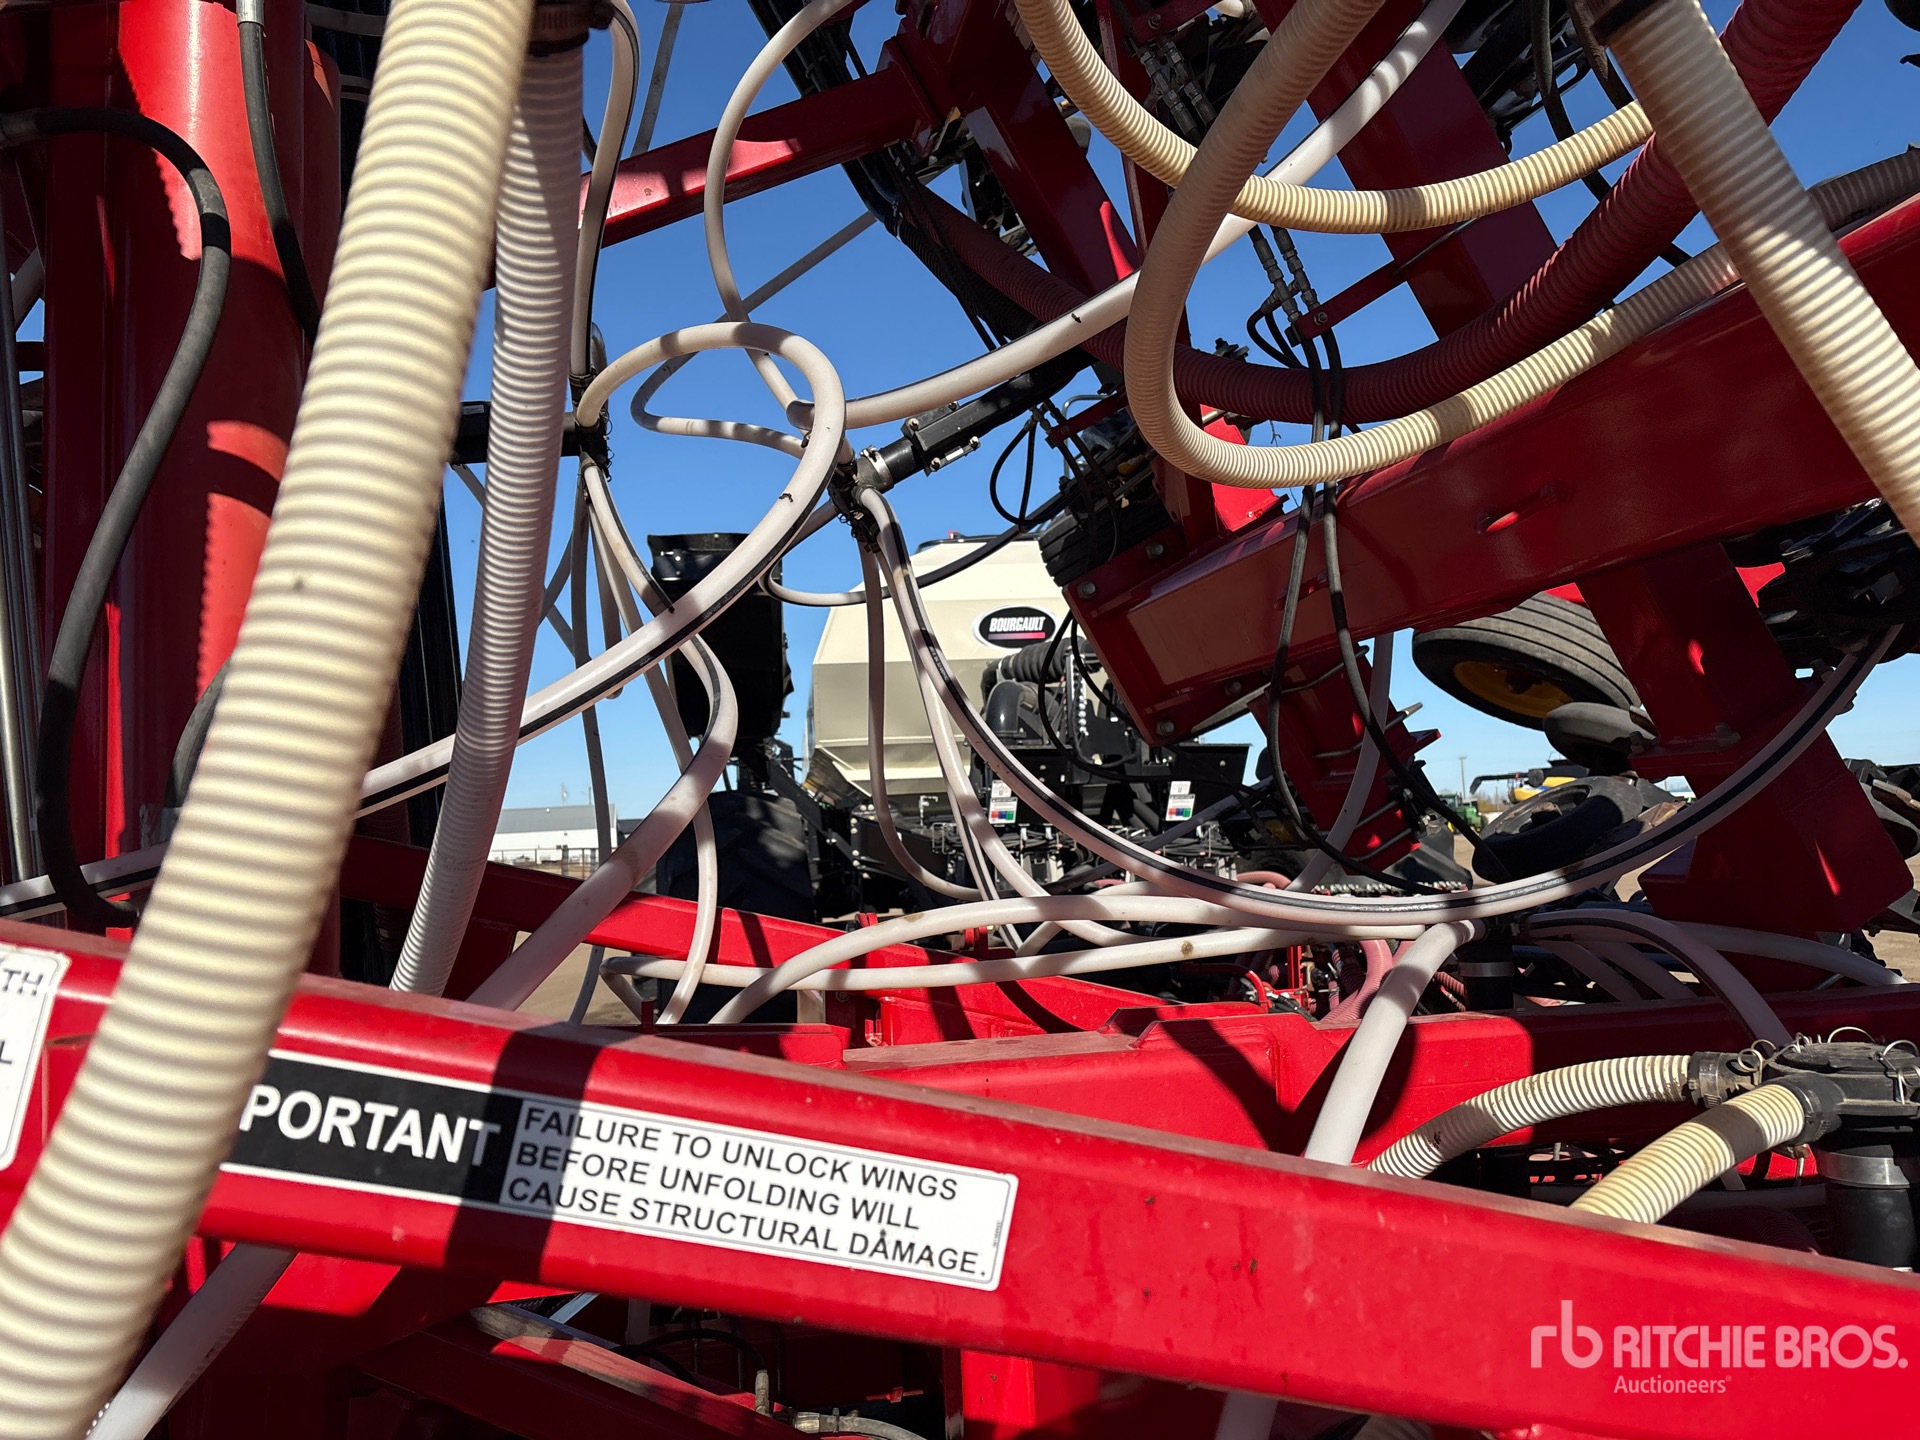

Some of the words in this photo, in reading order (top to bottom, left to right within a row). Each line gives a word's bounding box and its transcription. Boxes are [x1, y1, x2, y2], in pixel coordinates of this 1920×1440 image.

[989, 616, 1046, 632] BOURGAULT
[239, 1084, 501, 1166] PORTANT
[524, 1107, 661, 1151] FAILURE
[672, 1131, 712, 1158] TO
[722, 1141, 852, 1183] UNLOCK
[861, 1163, 957, 1200] WINGS
[508, 1177, 621, 1216] CAUSE
[630, 1197, 838, 1251] STRUCTURAL
[849, 1232, 987, 1277] DAMAGE.
[516, 1141, 650, 1185] BEFORE
[660, 1165, 840, 1216] UNFOLDING
[851, 1197, 919, 1230] WILL
